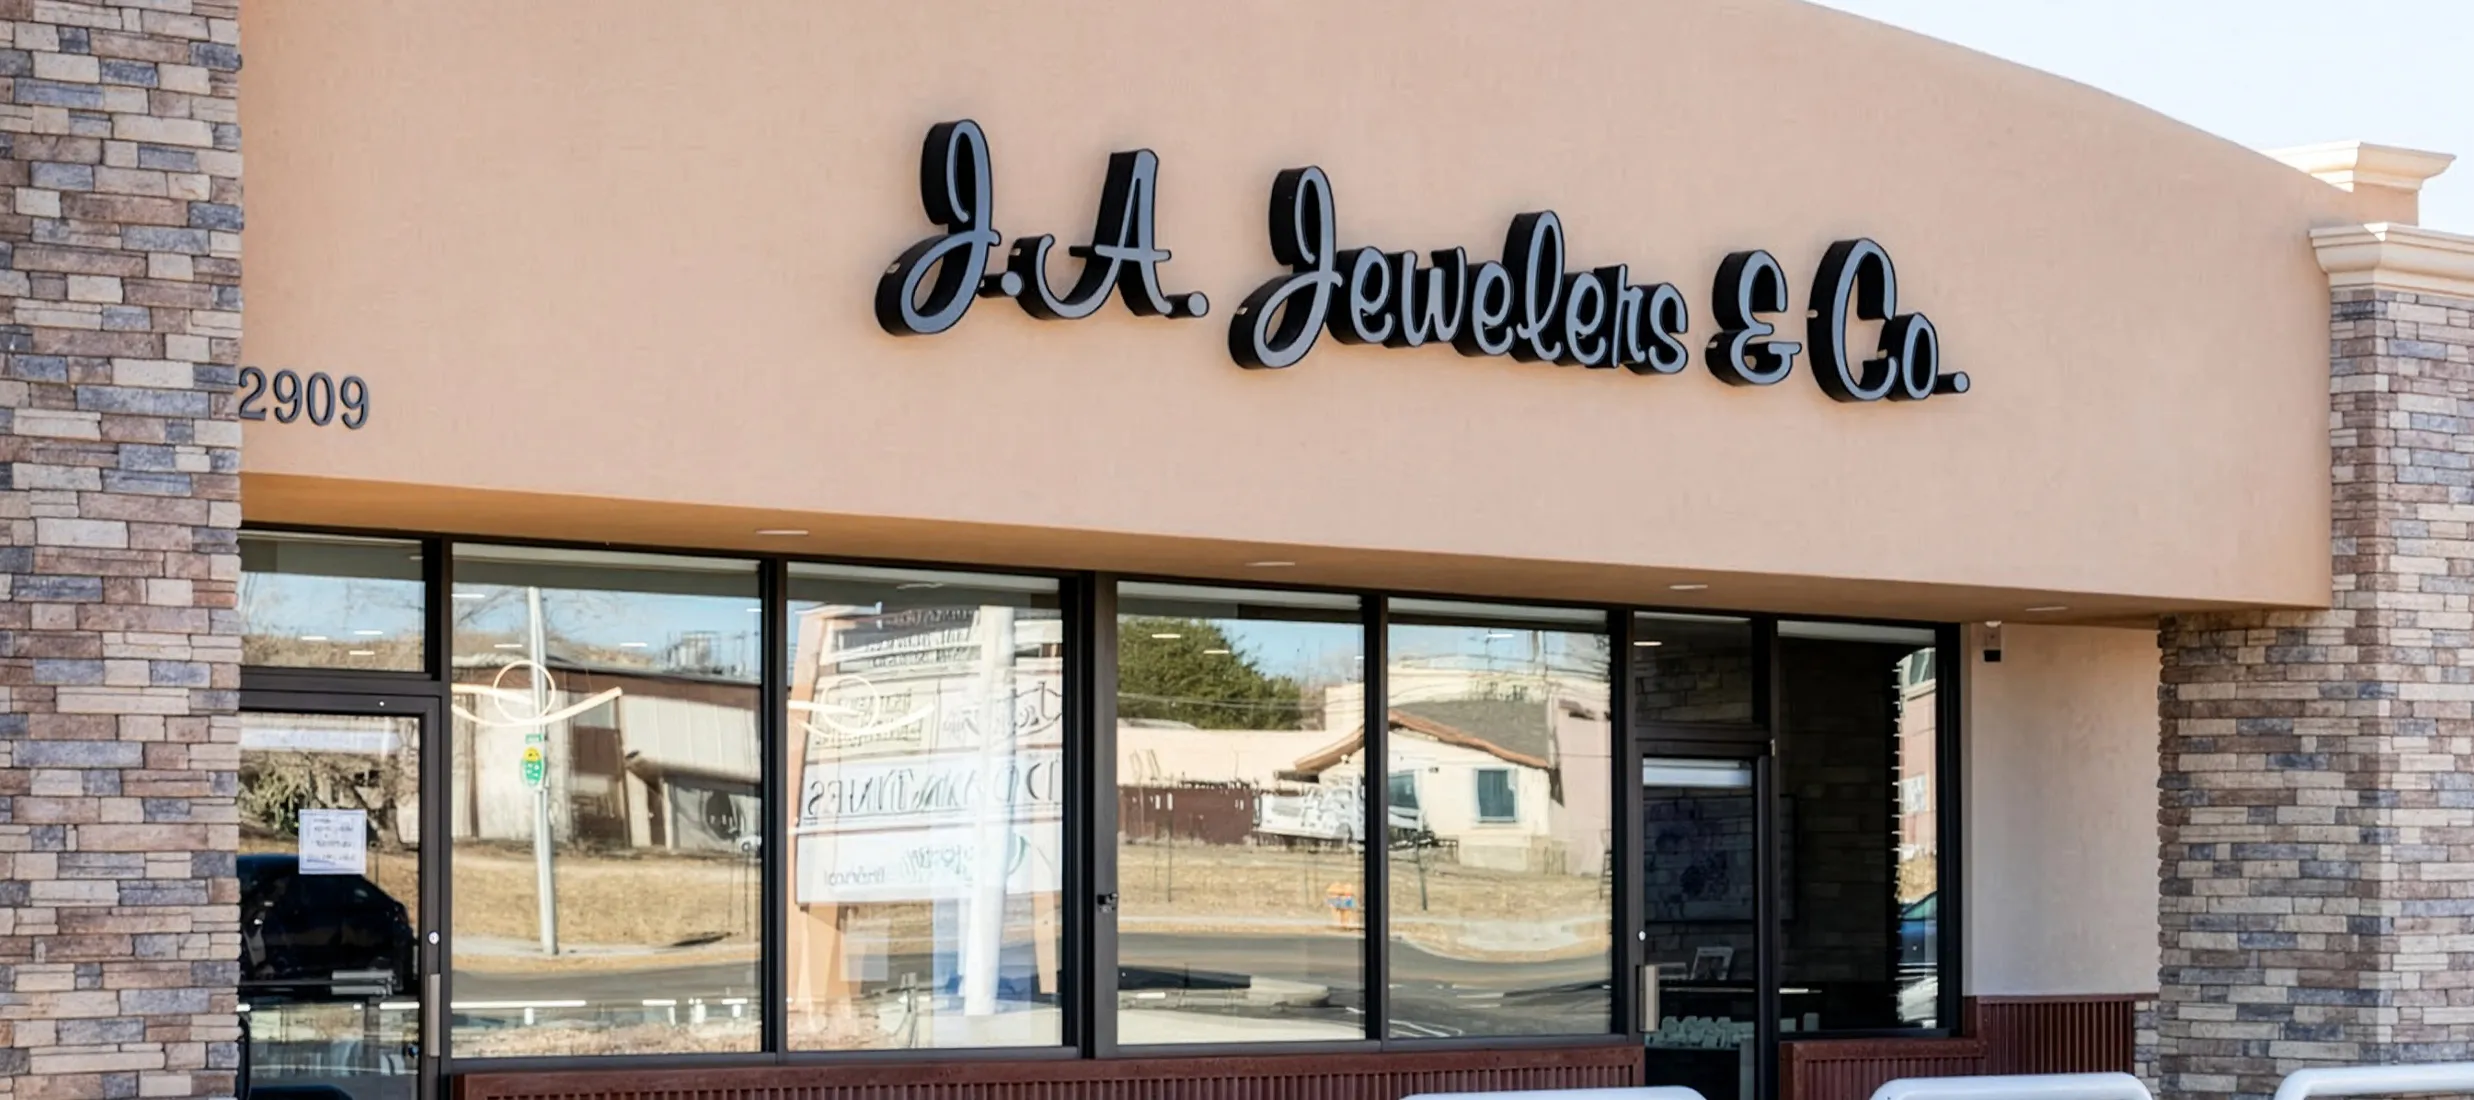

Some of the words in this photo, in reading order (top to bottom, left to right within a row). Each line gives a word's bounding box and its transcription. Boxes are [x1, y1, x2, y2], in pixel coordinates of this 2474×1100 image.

[875, 119, 1209, 336] J.A.
[1228, 165, 1688, 374] Jewelers
[1705, 250, 1802, 386] &
[1806, 238, 1970, 402] Co.
[239, 366, 369, 430] 2909
